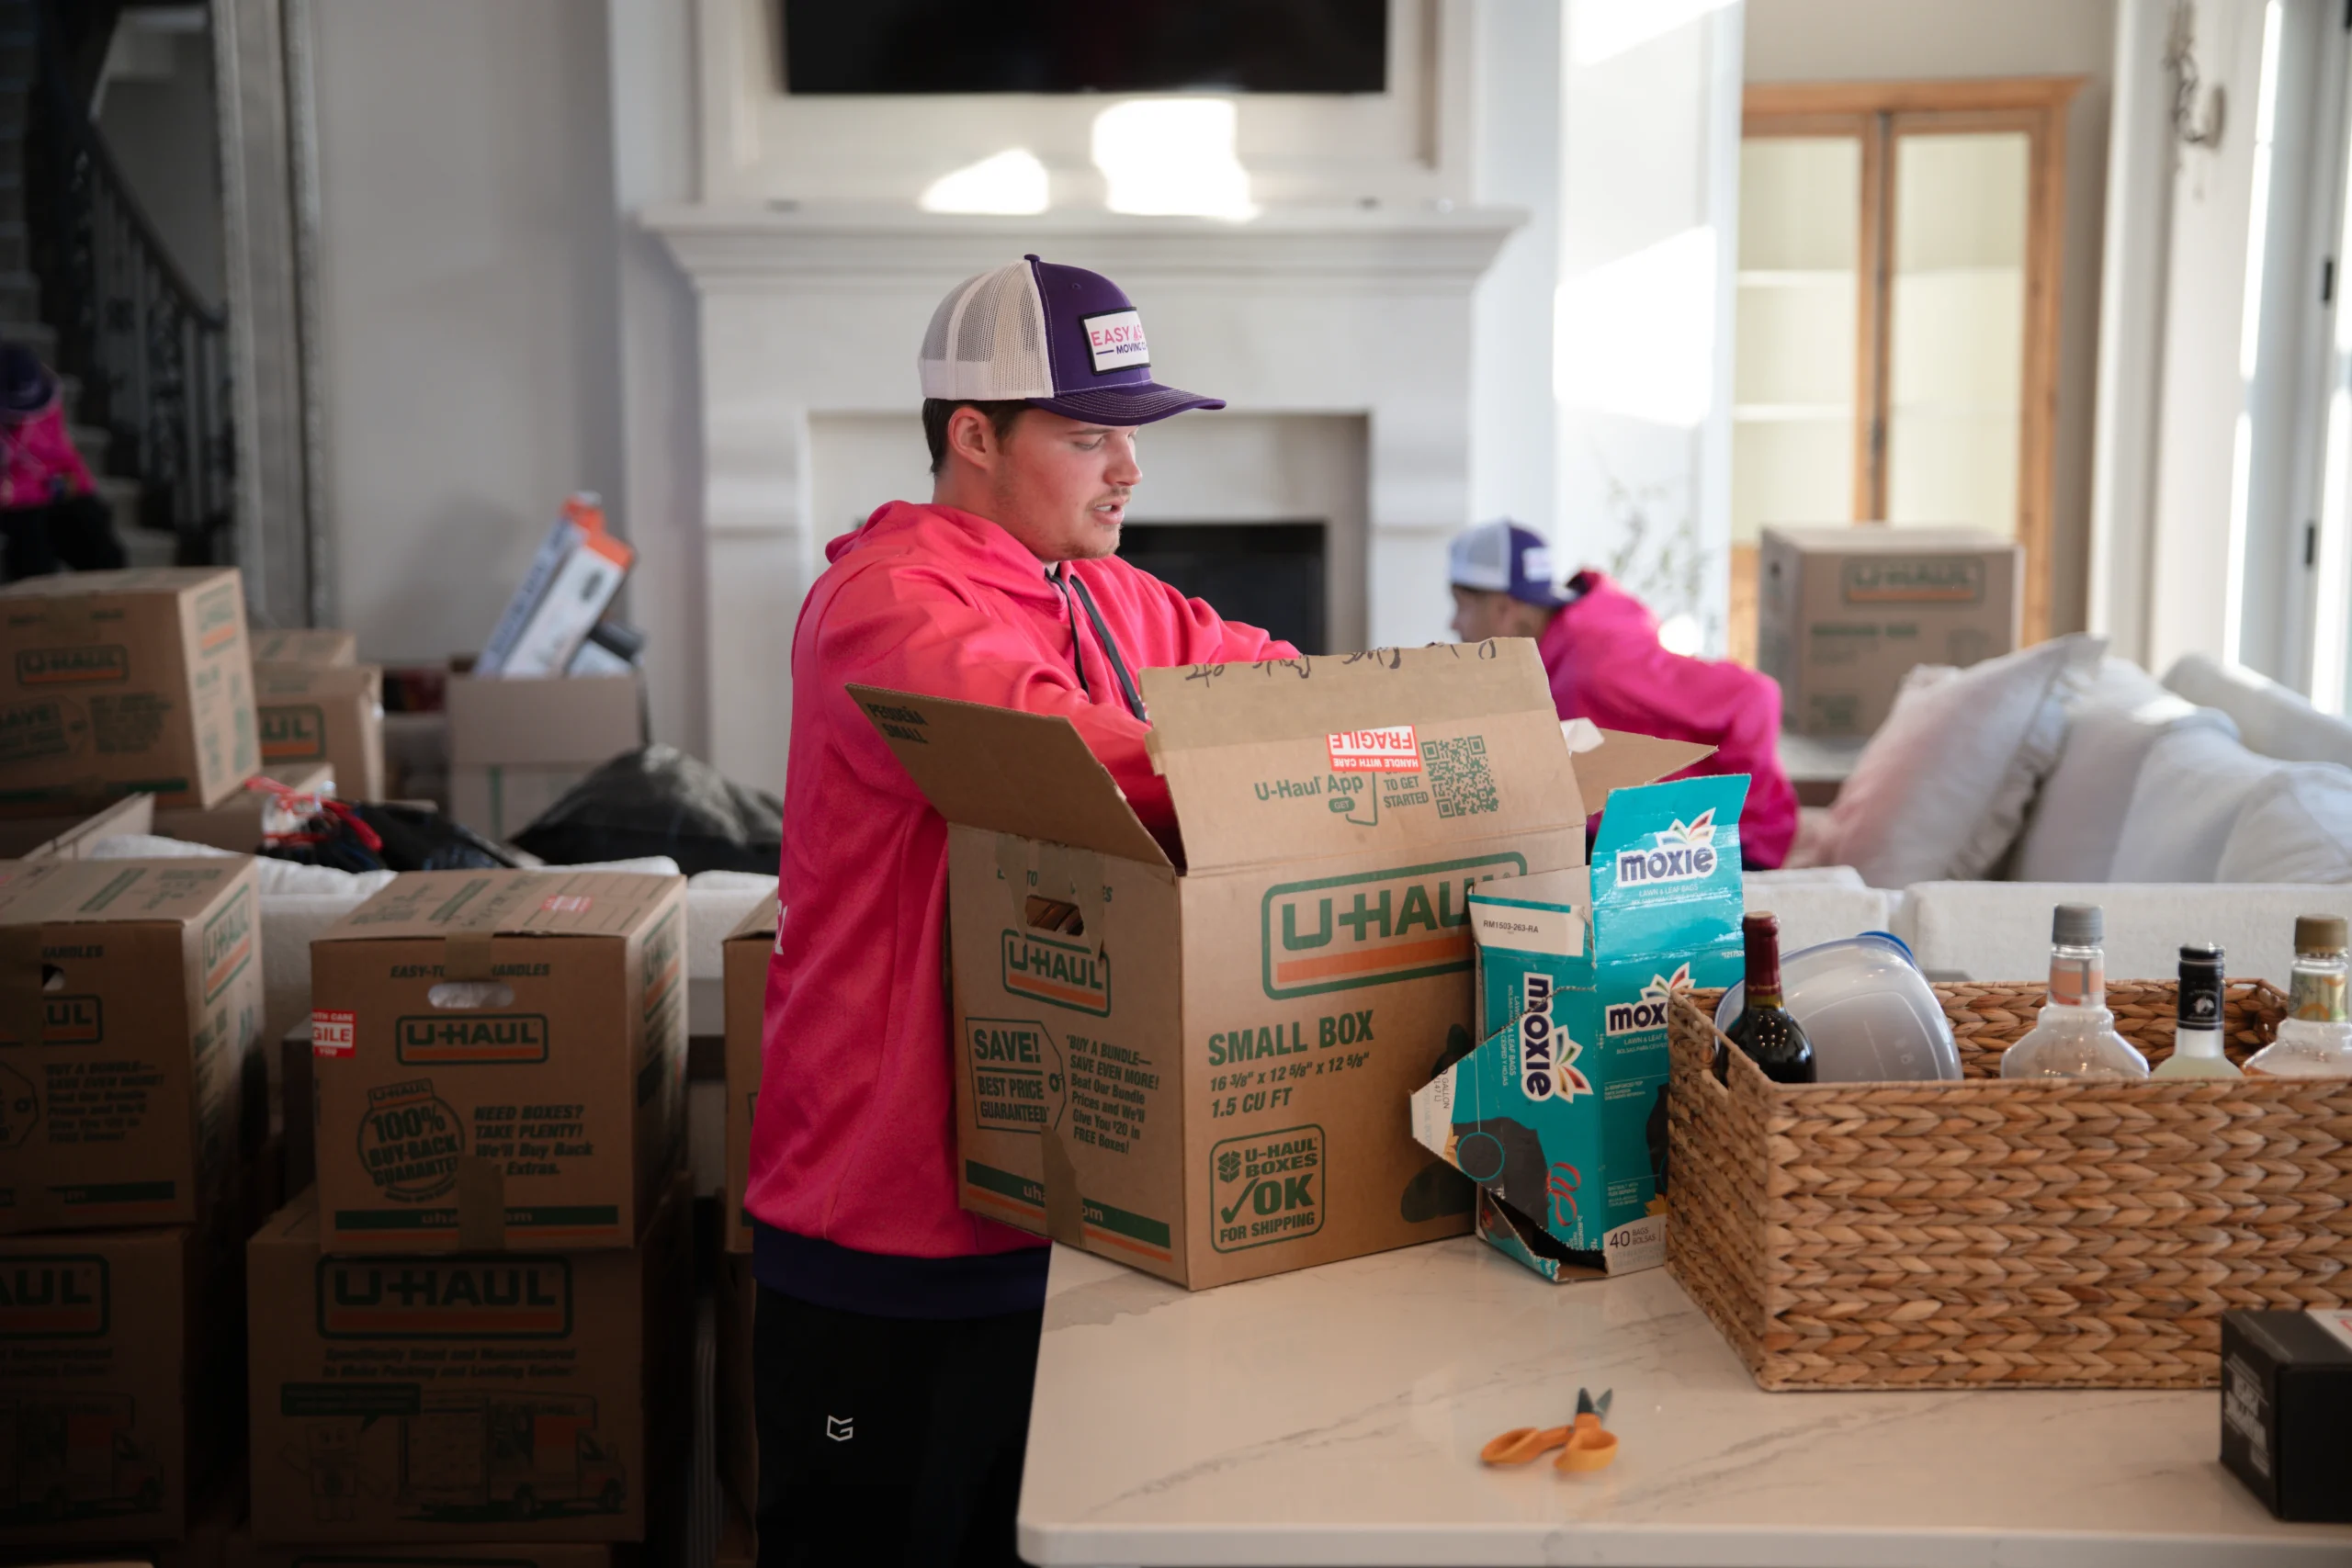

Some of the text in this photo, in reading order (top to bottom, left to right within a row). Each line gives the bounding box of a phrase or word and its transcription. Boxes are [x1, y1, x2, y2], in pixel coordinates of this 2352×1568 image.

[1091, 326, 1130, 346] EASY
[1331, 731, 1413, 750] FRAGILE
[1333, 757, 1419, 769] HANDLE WITH CARE
[1328, 774, 1364, 795] App
[1384, 775, 1419, 791] TO GET
[1383, 791, 1430, 808] STARTED
[1621, 847, 1713, 882] moxie
[1282, 876, 1493, 952] U-HAU
[1483, 919, 1539, 933] RM1503-263-RA
[1009, 941, 1103, 989] U-HAUL
[332, 1012, 354, 1021] CARE
[407, 1022, 538, 1045] U-HAUL
[974, 1028, 1041, 1063] SAVE!
[1208, 1010, 1374, 1066] SMALL BOX
[1524, 977, 1551, 1097] moxie
[1091, 1041, 1098, 1055] A
[1070, 1054, 1159, 1090] SAVE EVEN MORE!
[1210, 1076, 1227, 1092] 16
[1257, 1072, 1265, 1084] x
[1271, 1066, 1286, 1082] 12
[1316, 1062, 1324, 1075] x
[1329, 1056, 1344, 1073] 12
[373, 1084, 428, 1100] U-HAUL
[977, 1076, 1044, 1100] BEST PRICE
[1071, 1072, 1145, 1104] Beat Our Bundle
[1442, 1077, 1450, 1109] GALLON
[474, 1104, 584, 1121] NEED BOXES?
[1072, 1090, 1146, 1123] Prices and We'll
[1212, 1087, 1293, 1118] 1.5 CU FT
[370, 1102, 447, 1143] 100%
[475, 1122, 583, 1140] TAKE PLENTY!
[1072, 1108, 1141, 1139] Give You $20 in
[368, 1134, 458, 1167] BUY-BACK
[476, 1140, 594, 1161] We'll Buy Back
[1074, 1125, 1129, 1155] FREE Boxes!
[1245, 1138, 1317, 1162] U-HAUL
[506, 1161, 560, 1176] Extras.
[1245, 1153, 1318, 1179] BOXES
[1253, 1173, 1316, 1215] OK
[1220, 1211, 1315, 1243] FOR SHIPPING
[1610, 1230, 1631, 1247] 40
[1633, 1226, 1649, 1236] BAGS
[1633, 1234, 1657, 1245] BOLSAS
[334, 1269, 558, 1307] U-HAUL
